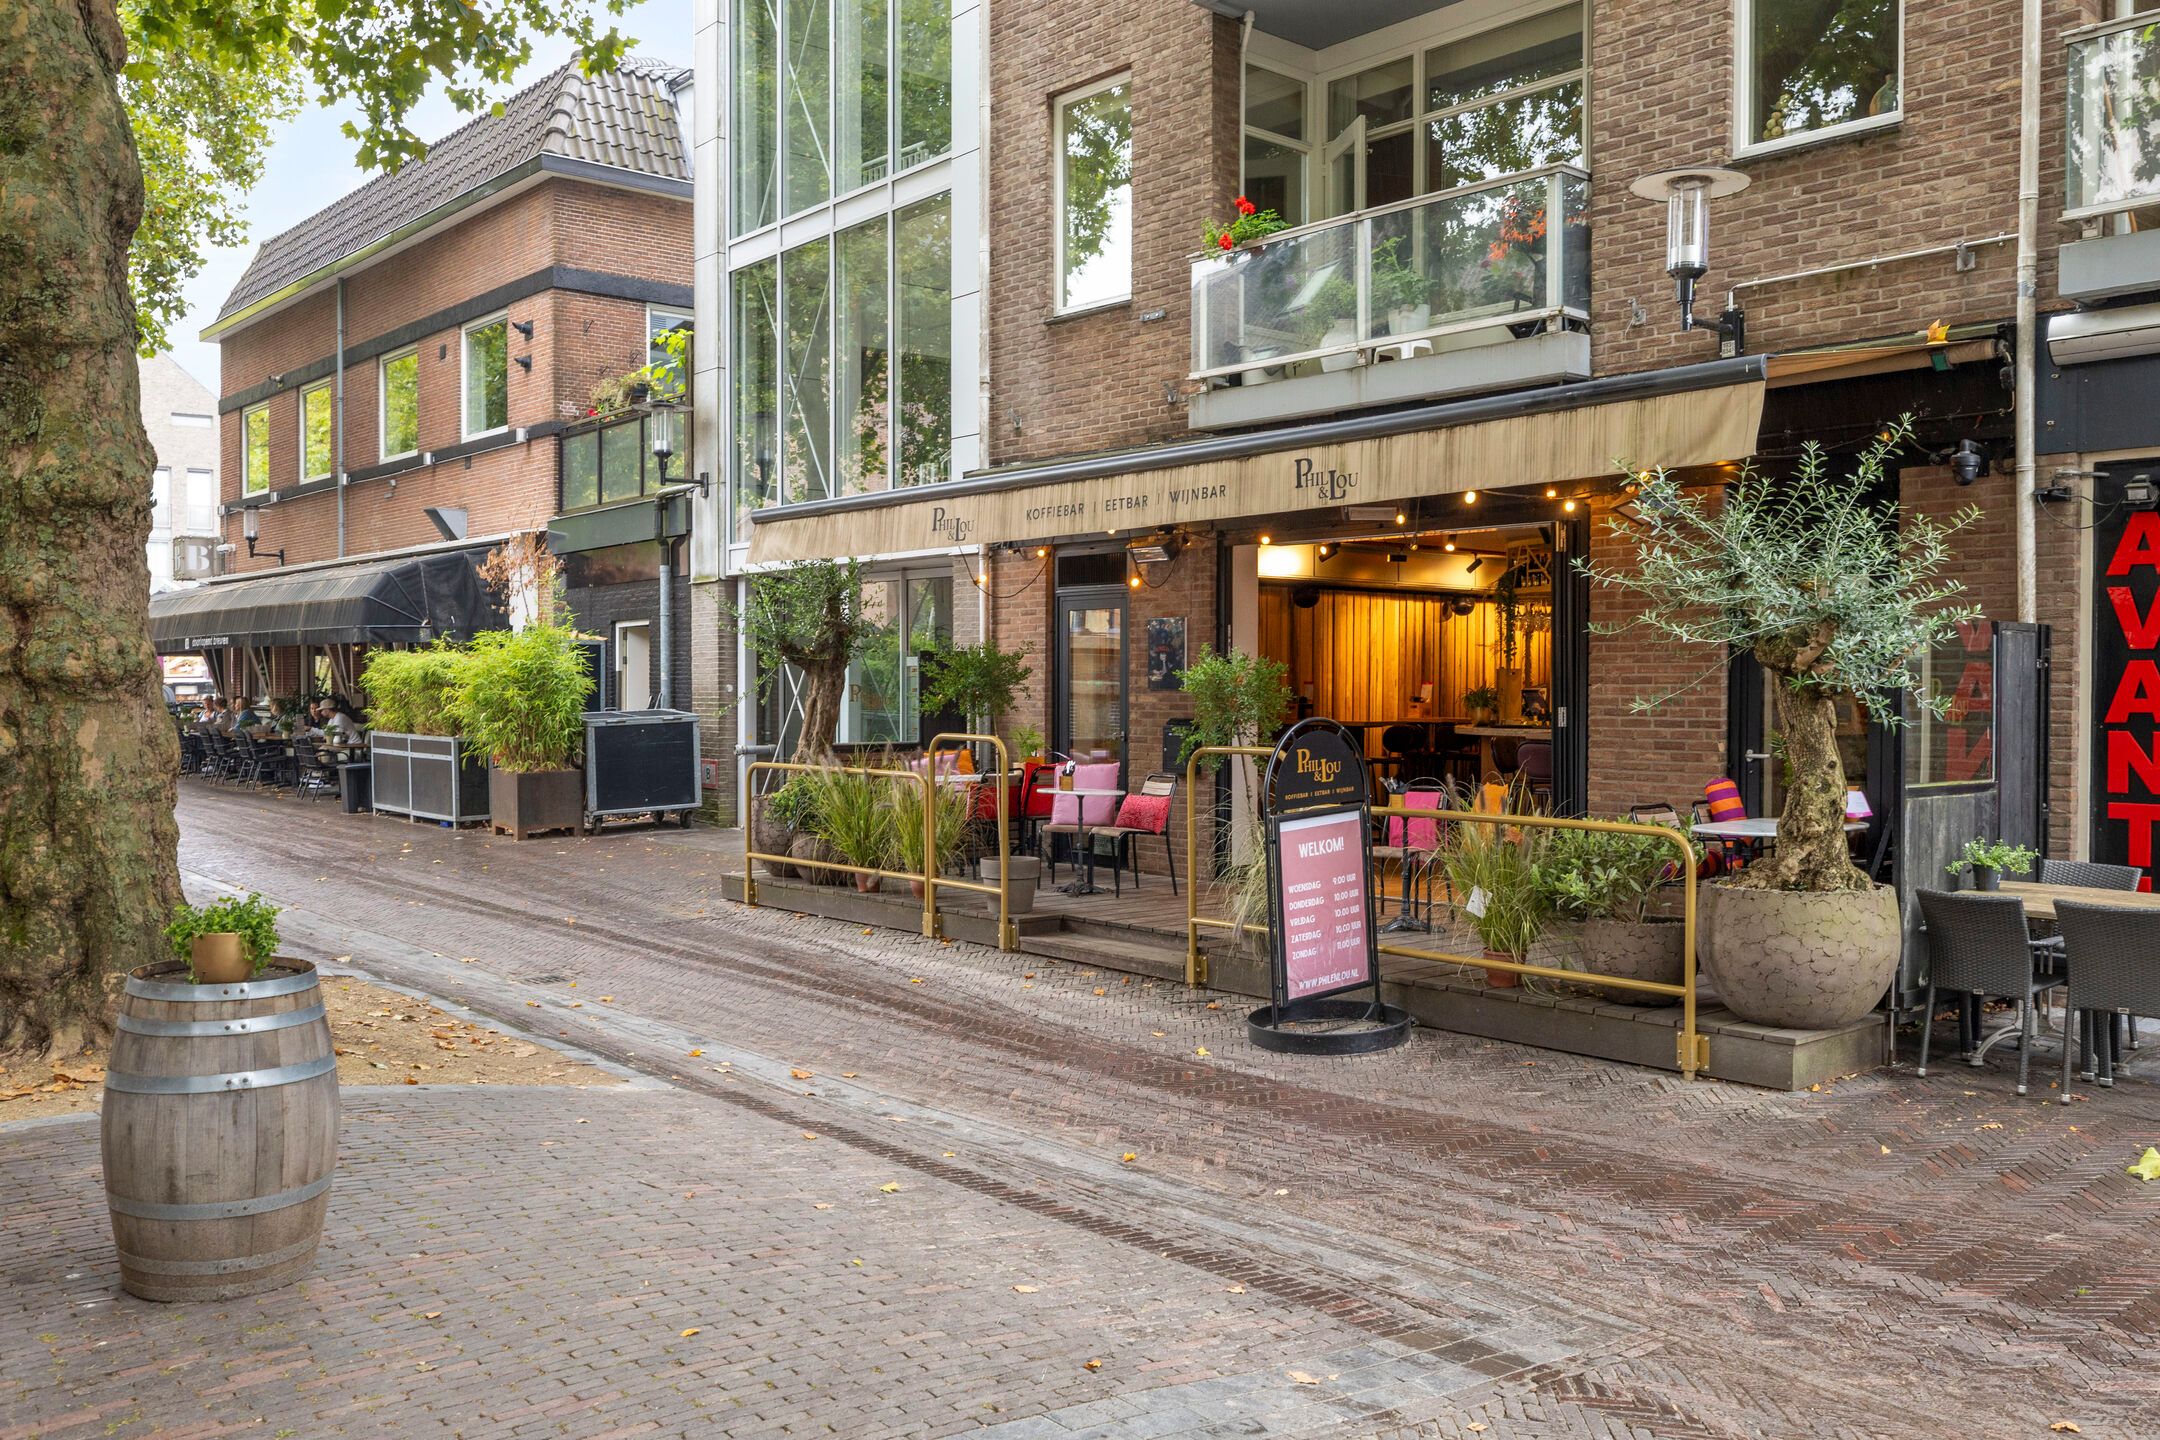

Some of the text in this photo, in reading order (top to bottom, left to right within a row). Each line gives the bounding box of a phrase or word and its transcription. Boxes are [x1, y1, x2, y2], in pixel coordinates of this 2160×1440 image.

[1026, 484, 1227, 521] KOFFIEBAR EETBAR WIJNBAR
[2105, 511, 2160, 892] AVANT
[1298, 836, 1344, 858] WELKOM!
[1288, 873, 1356, 894] WOENSDAG 9.00 UUR
[1289, 888, 1359, 911] DONDERDAG 10.00 UUR
[1290, 904, 1360, 927] VRIJDAG 10.00 UUR
[1291, 920, 1361, 944] ZATERDAG 10.00 UUR
[1292, 947, 1317, 960] ZONDAG
[1350, 937, 1361, 946] UUR
